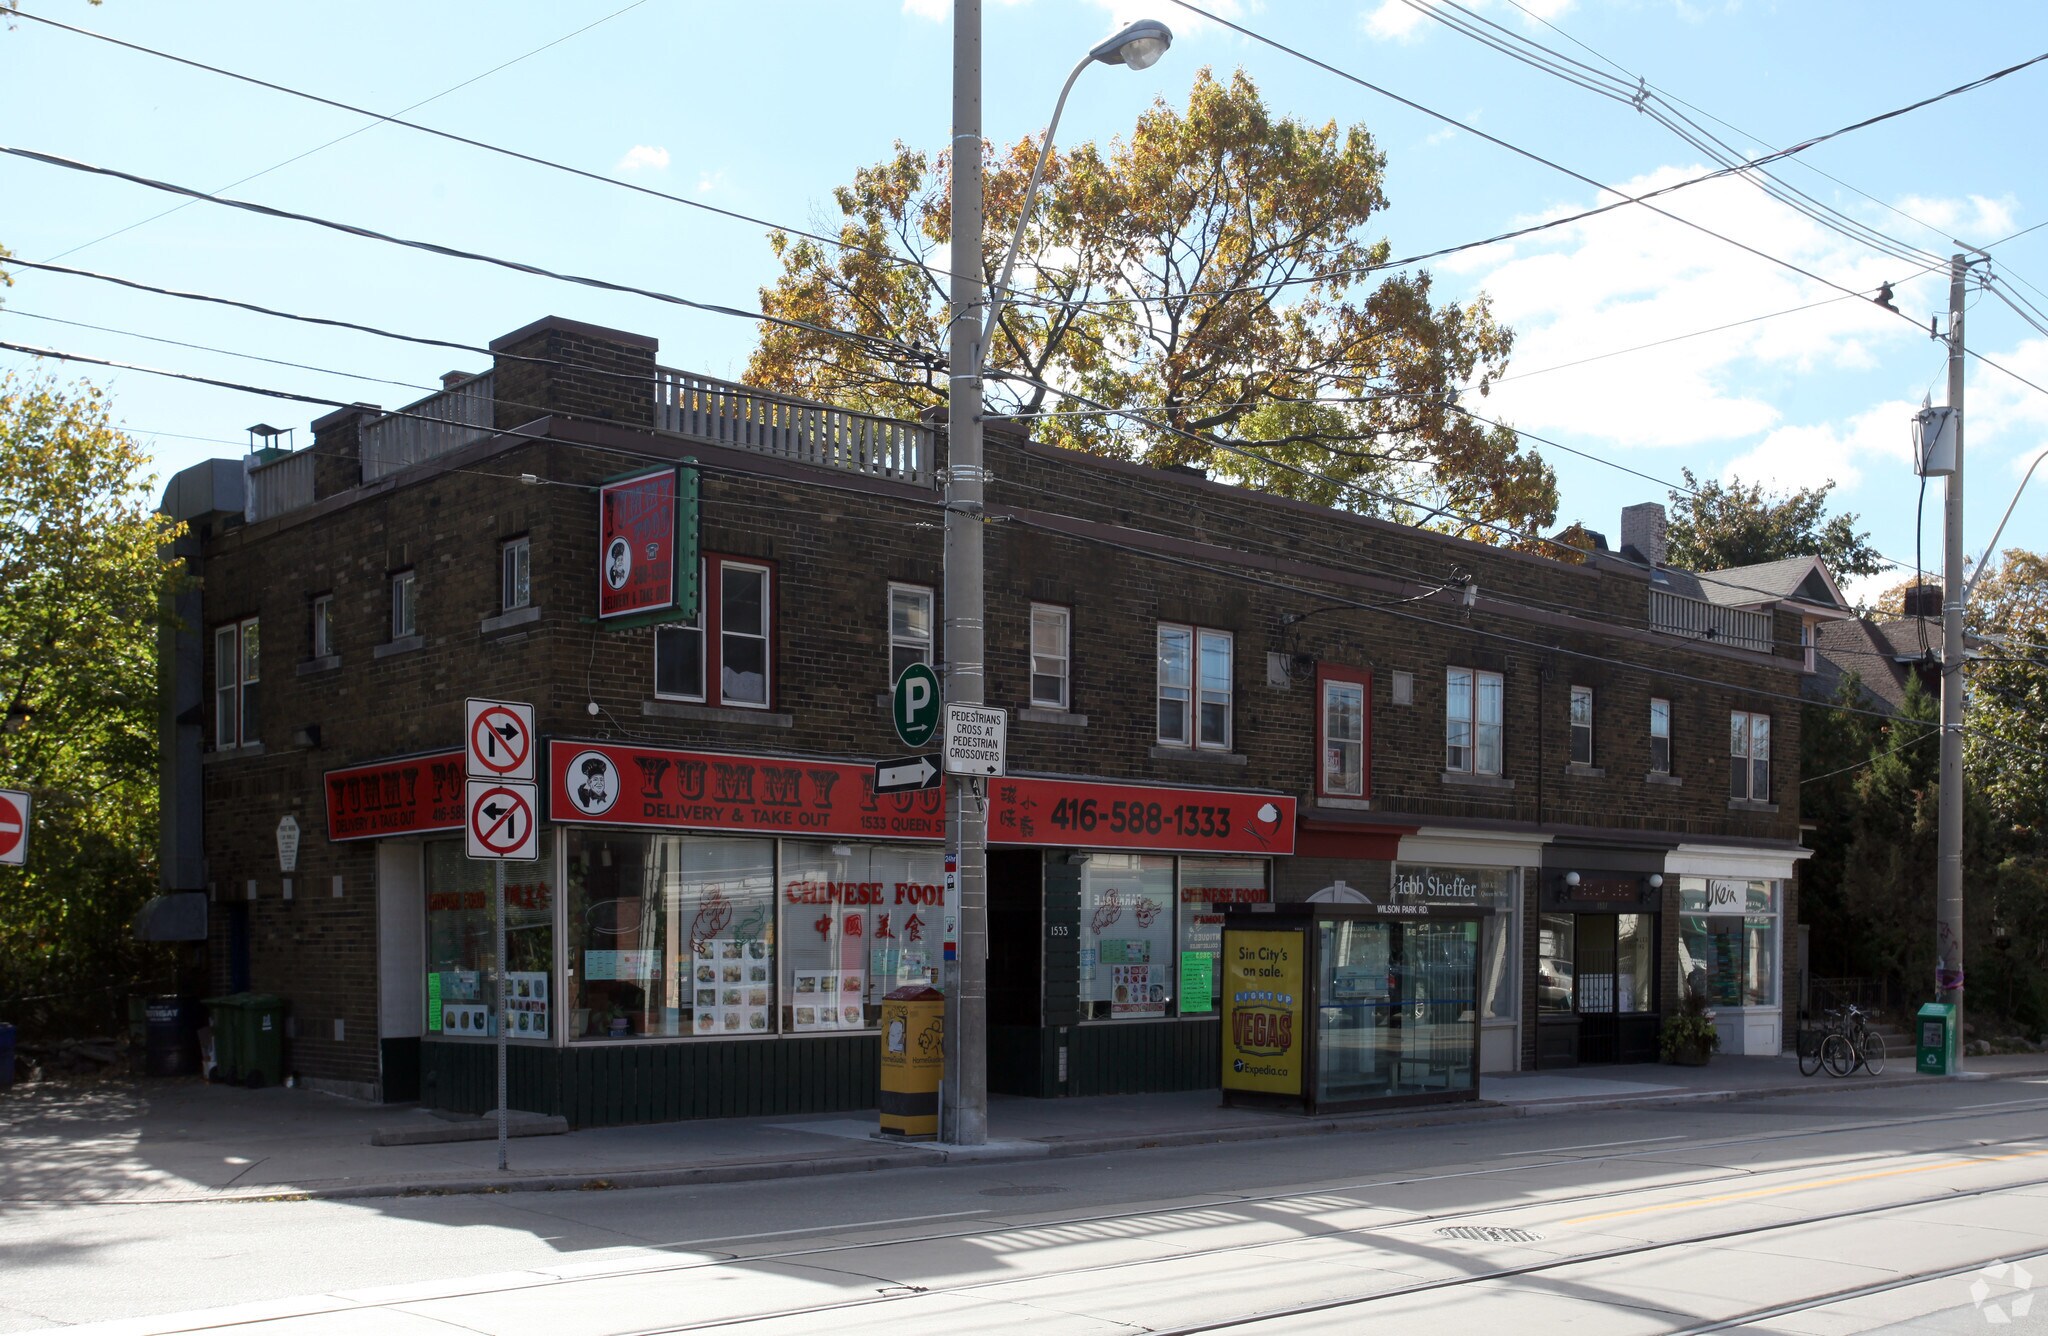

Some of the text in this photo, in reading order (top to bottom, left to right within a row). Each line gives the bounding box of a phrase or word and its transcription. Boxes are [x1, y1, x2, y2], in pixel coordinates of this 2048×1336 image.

[906, 676, 931, 724] P
[951, 711, 1001, 726] PEDESTRIANS
[956, 724, 994, 737] CROSS AT
[953, 736, 998, 749] PEDESTRIAN
[950, 748, 1000, 762] CROSSOVERS
[331, 767, 419, 815] YUMMY
[633, 756, 840, 809] YUMMY
[861, 774, 942, 815] FOO
[336, 817, 369, 832] DELIVERY
[380, 813, 399, 828] TAKE
[401, 810, 416, 826] OUT
[643, 803, 831, 827] DELIVERY & TAKE OUT
[861, 816, 887, 829] 1533
[891, 817, 931, 831] QUEEN
[1051, 798, 1231, 837] 416-588-1333
[786, 881, 884, 905] CHINESE
[1181, 887, 1268, 904] CHINESE FOOD
[1427, 877, 1476, 897] Sheffer
[1377, 905, 1429, 914] WILSON PARK RD.
[1051, 926, 1069, 936] 1533
[1239, 947, 1287, 964] Sin City's
[1243, 964, 1283, 977] on sale.
[1236, 991, 1291, 1004] LIGHT UP
[1232, 1013, 1292, 1049] VEGAS
[1245, 1062, 1288, 1076] Expedia.ca
